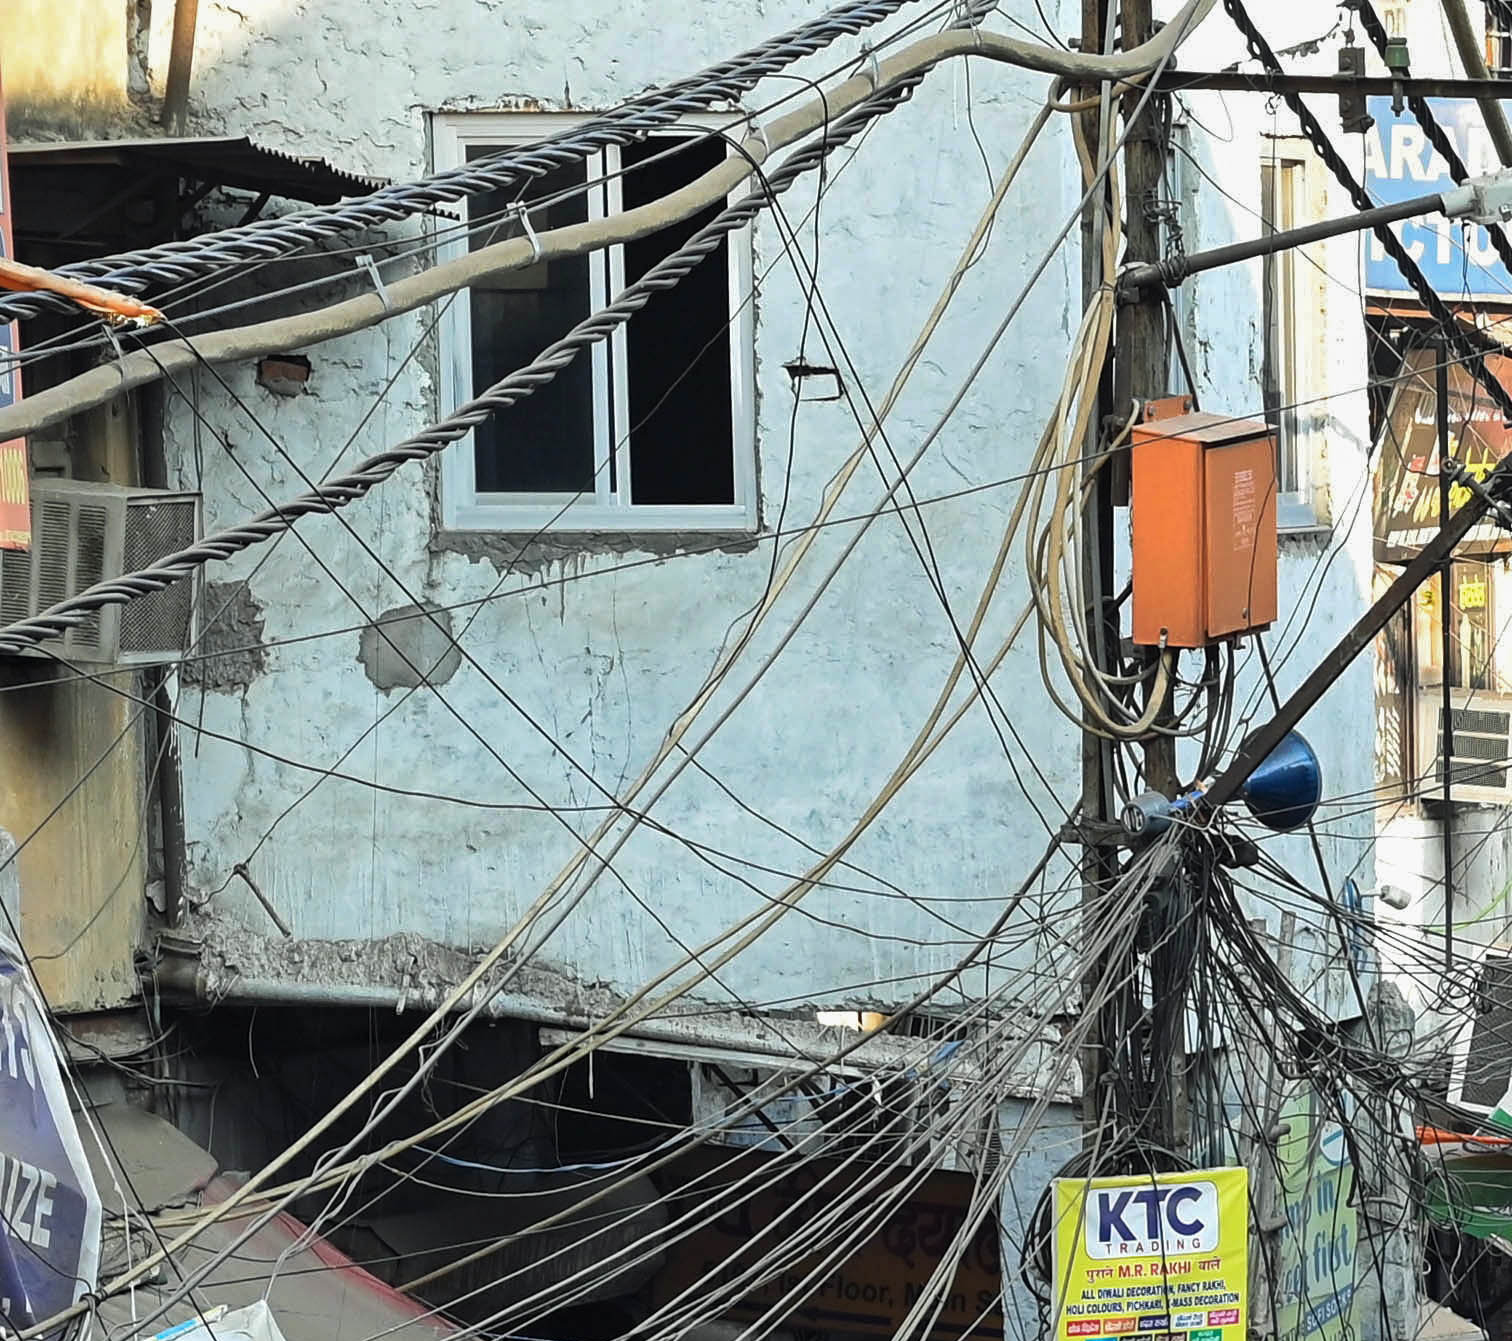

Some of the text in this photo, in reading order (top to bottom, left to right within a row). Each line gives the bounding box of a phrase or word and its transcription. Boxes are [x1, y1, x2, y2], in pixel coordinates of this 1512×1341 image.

[1098, 1186, 1205, 1243] KTC
[1106, 1238, 1202, 1255] TRADING
[1118, 1264, 1148, 1278] M.R.
[1150, 1261, 1192, 1276] RAKHI
[1081, 1289, 1096, 1300] ALL
[1097, 1287, 1124, 1299] DIWALI
[1126, 1284, 1176, 1298] DECORATIN,
[1176, 1282, 1200, 1294] FANCY
[1066, 1304, 1085, 1316] HOLI
[1167, 1295, 1194, 1310] -MASS
[1195, 1292, 1240, 1307] DECORATION
